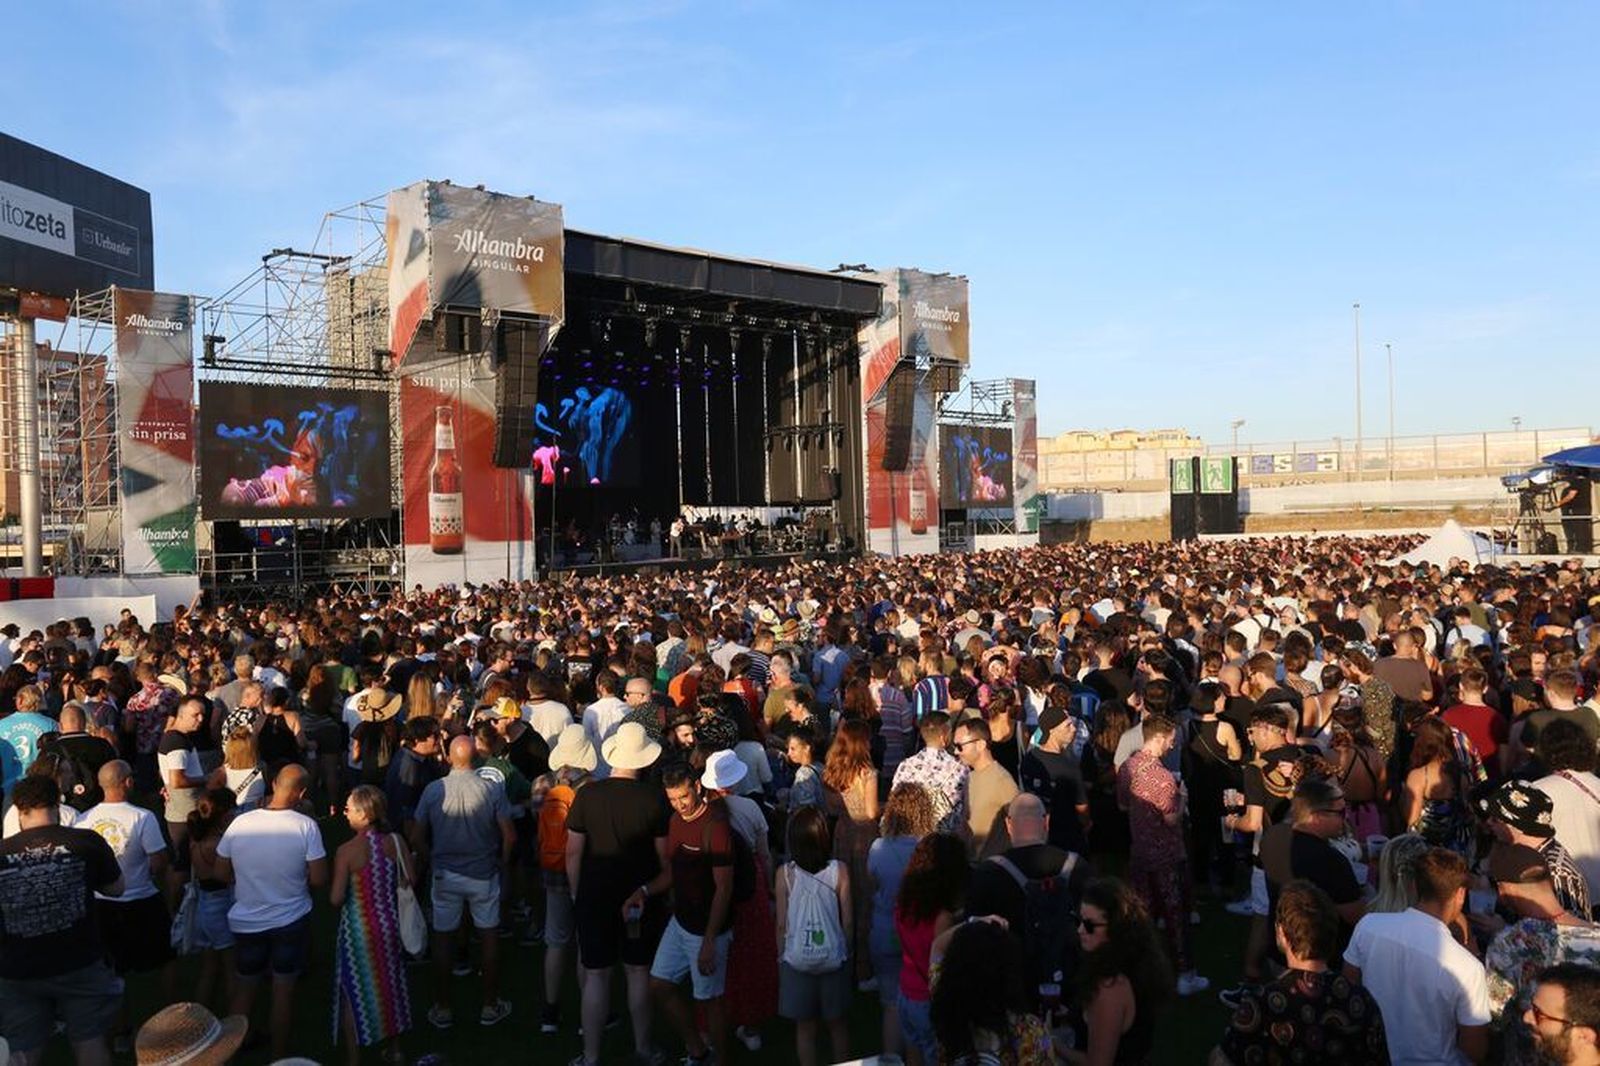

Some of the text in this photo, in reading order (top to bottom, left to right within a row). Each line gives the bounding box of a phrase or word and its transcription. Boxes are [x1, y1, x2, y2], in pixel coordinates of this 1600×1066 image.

[453, 229, 544, 263] Alhambra
[472, 259, 530, 274] SINGULAR
[912, 301, 960, 323] Alhambra
[125, 313, 183, 331] Alhambra
[411, 373, 434, 387] sin
[129, 426, 187, 444] sin prisa
[14, 735, 30, 760] 3
